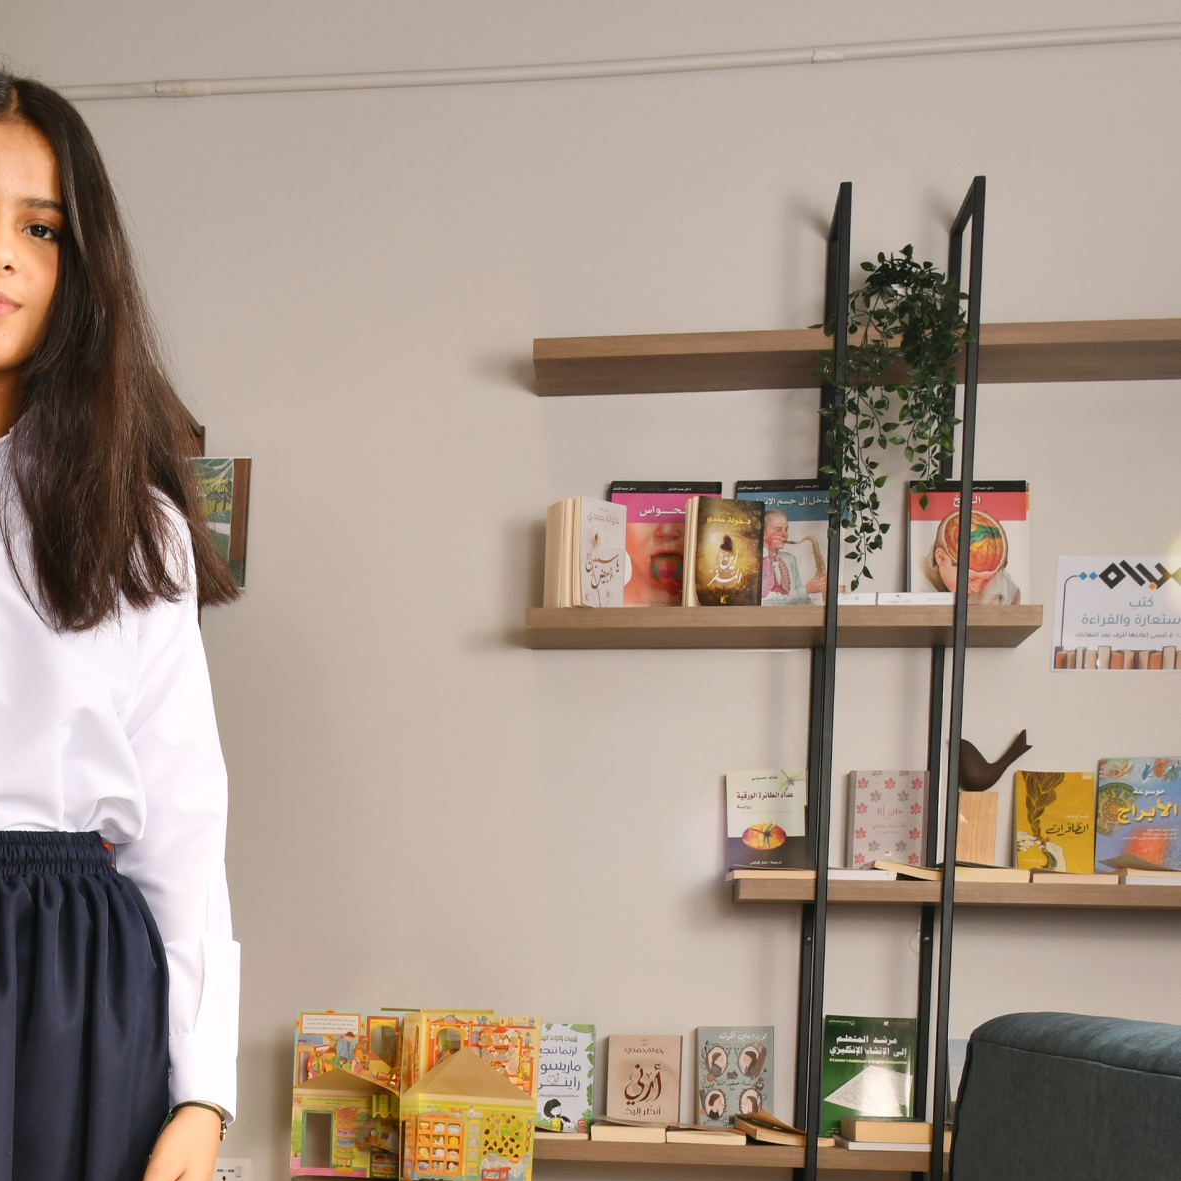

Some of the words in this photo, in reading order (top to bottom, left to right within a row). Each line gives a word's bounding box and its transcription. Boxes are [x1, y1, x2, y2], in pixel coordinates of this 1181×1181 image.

[1129, 596, 1154, 610] كتب
[1081, 613, 1130, 627] والقراءة
[1132, 786, 1165, 797] موسوعة
[1117, 798, 1178, 825] الأبراج
[836, 1034, 869, 1044] المتعلم
[872, 1036, 897, 1046] مرشد
